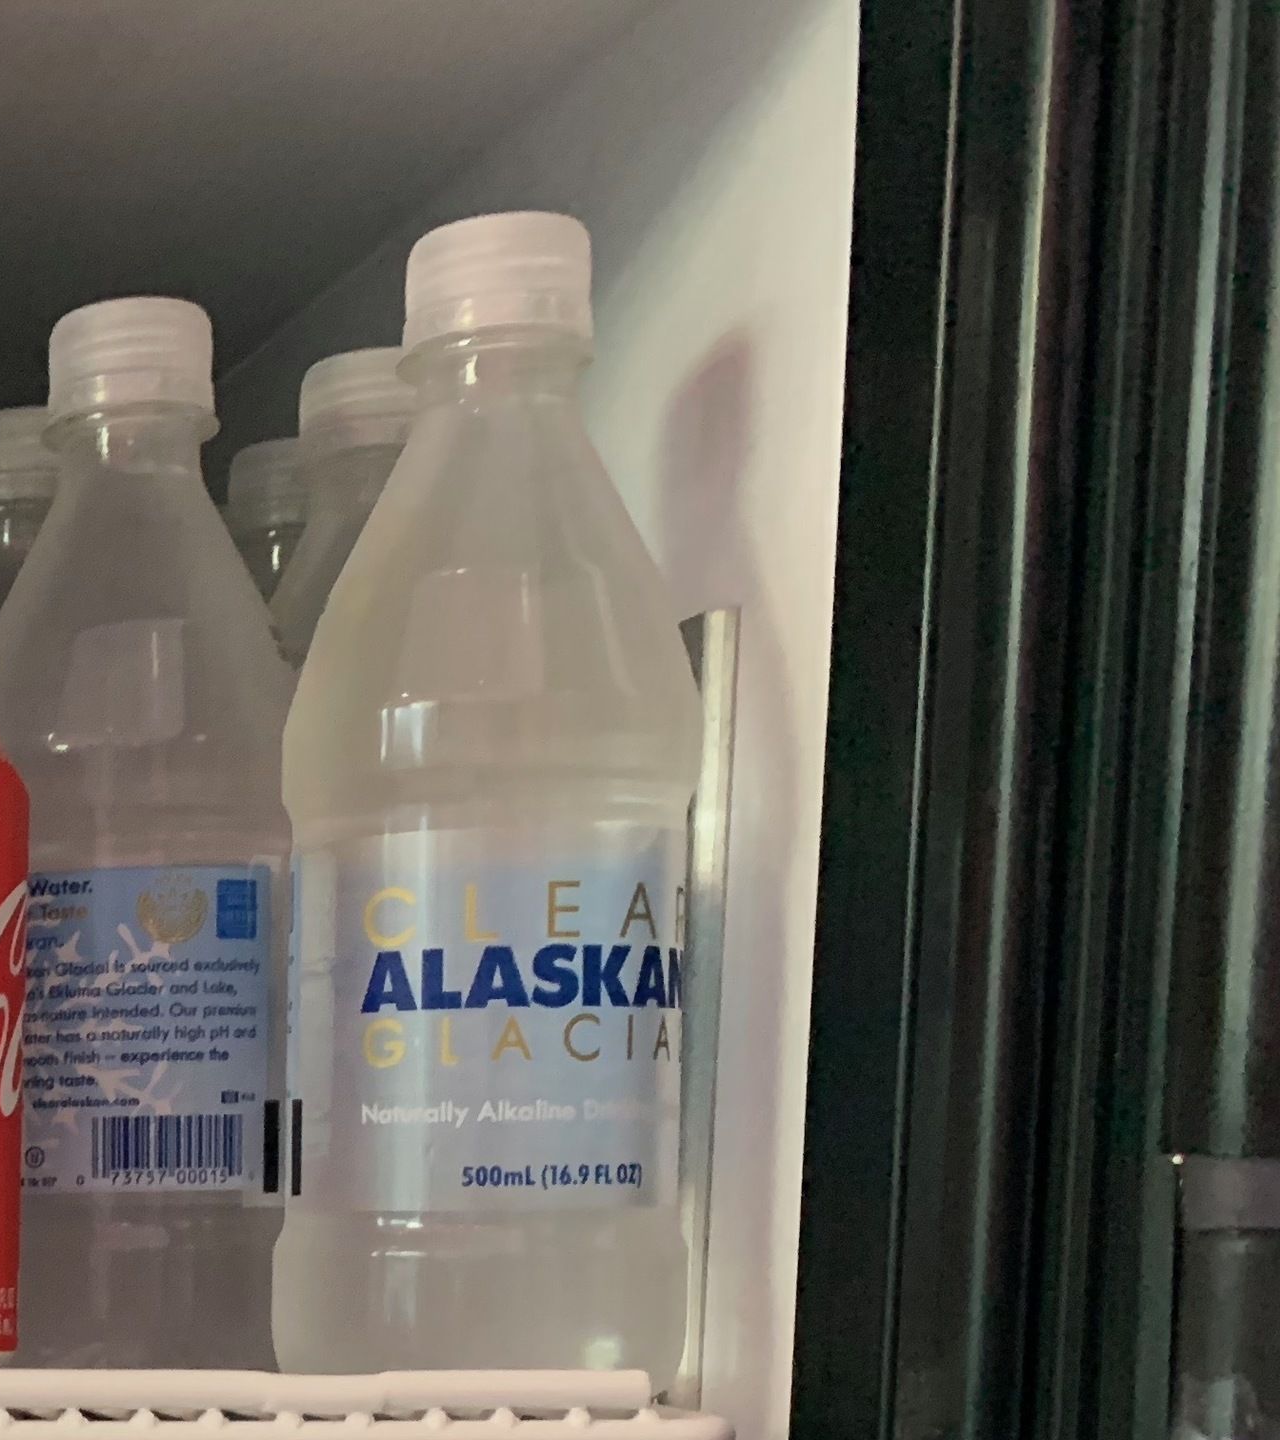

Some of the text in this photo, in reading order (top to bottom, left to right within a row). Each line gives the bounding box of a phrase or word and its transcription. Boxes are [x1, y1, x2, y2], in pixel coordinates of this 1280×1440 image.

[169, 980, 197, 995] and
[169, 1002, 197, 1017] Our
[101, 1025, 170, 1043] naturally
[174, 1024, 206, 1041] high
[63, 1045, 230, 1066] finish experience the
[361, 1101, 469, 1129] Naturally
[477, 1099, 576, 1123] Alkaline
[461, 1162, 642, 1190] 500mL (16.9 FL OZ)
